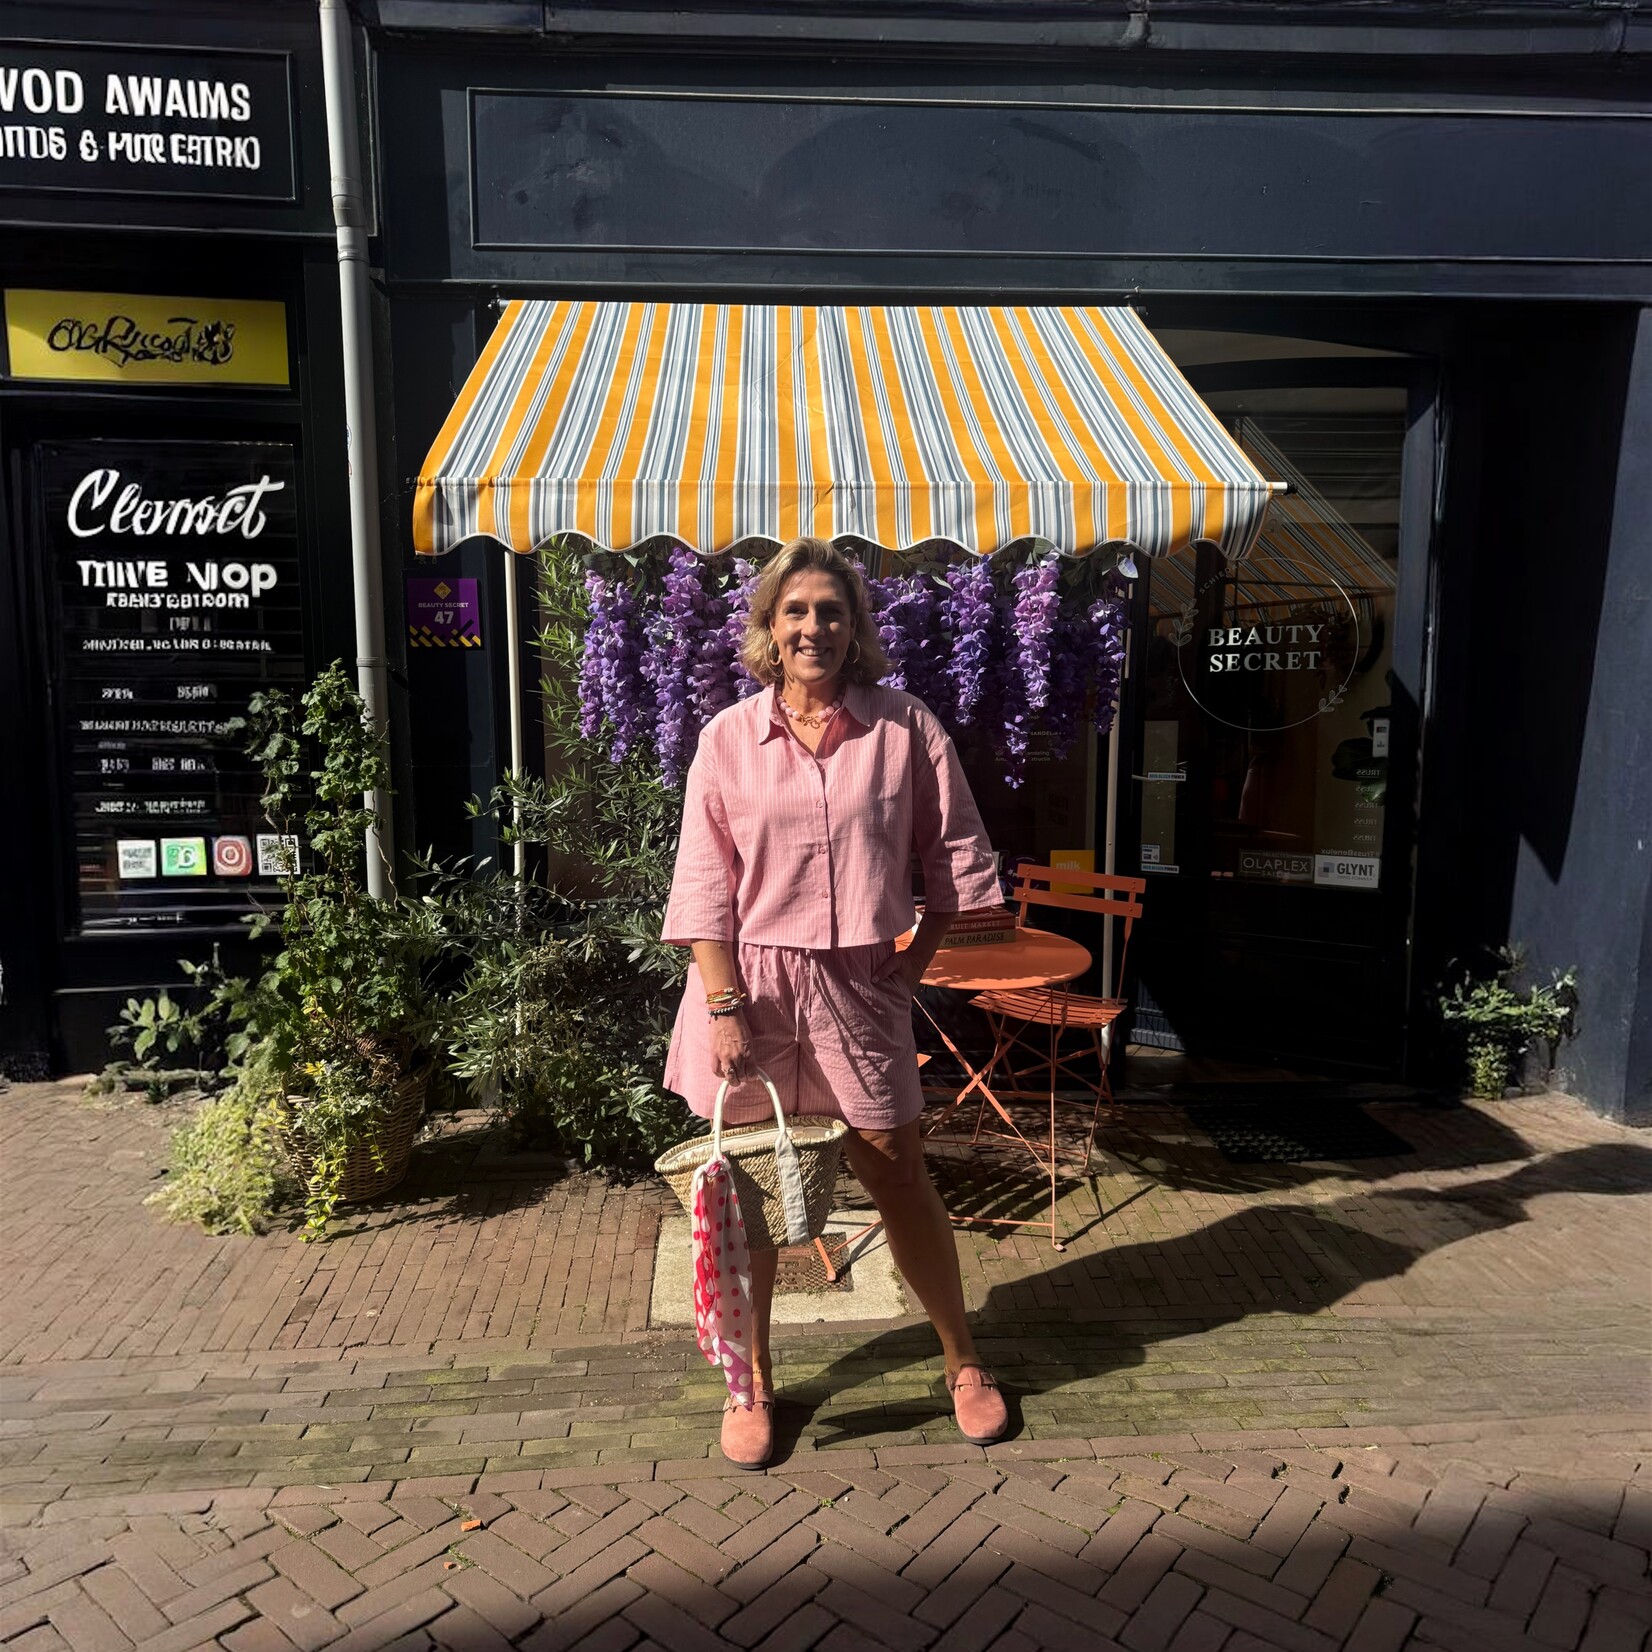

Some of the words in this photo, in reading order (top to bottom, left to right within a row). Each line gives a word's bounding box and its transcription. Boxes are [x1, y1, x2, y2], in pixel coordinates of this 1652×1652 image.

[434, 611, 454, 625] 47
[1208, 624, 1325, 646] BEAUTY
[1209, 651, 1321, 672] SECRET
[1056, 860, 1080, 871] milk
[1243, 857, 1308, 873] OLAPLEX
[1337, 862, 1374, 876] GLYNT
[944, 937, 965, 945] PALM
[966, 932, 1005, 944] PARADISE
